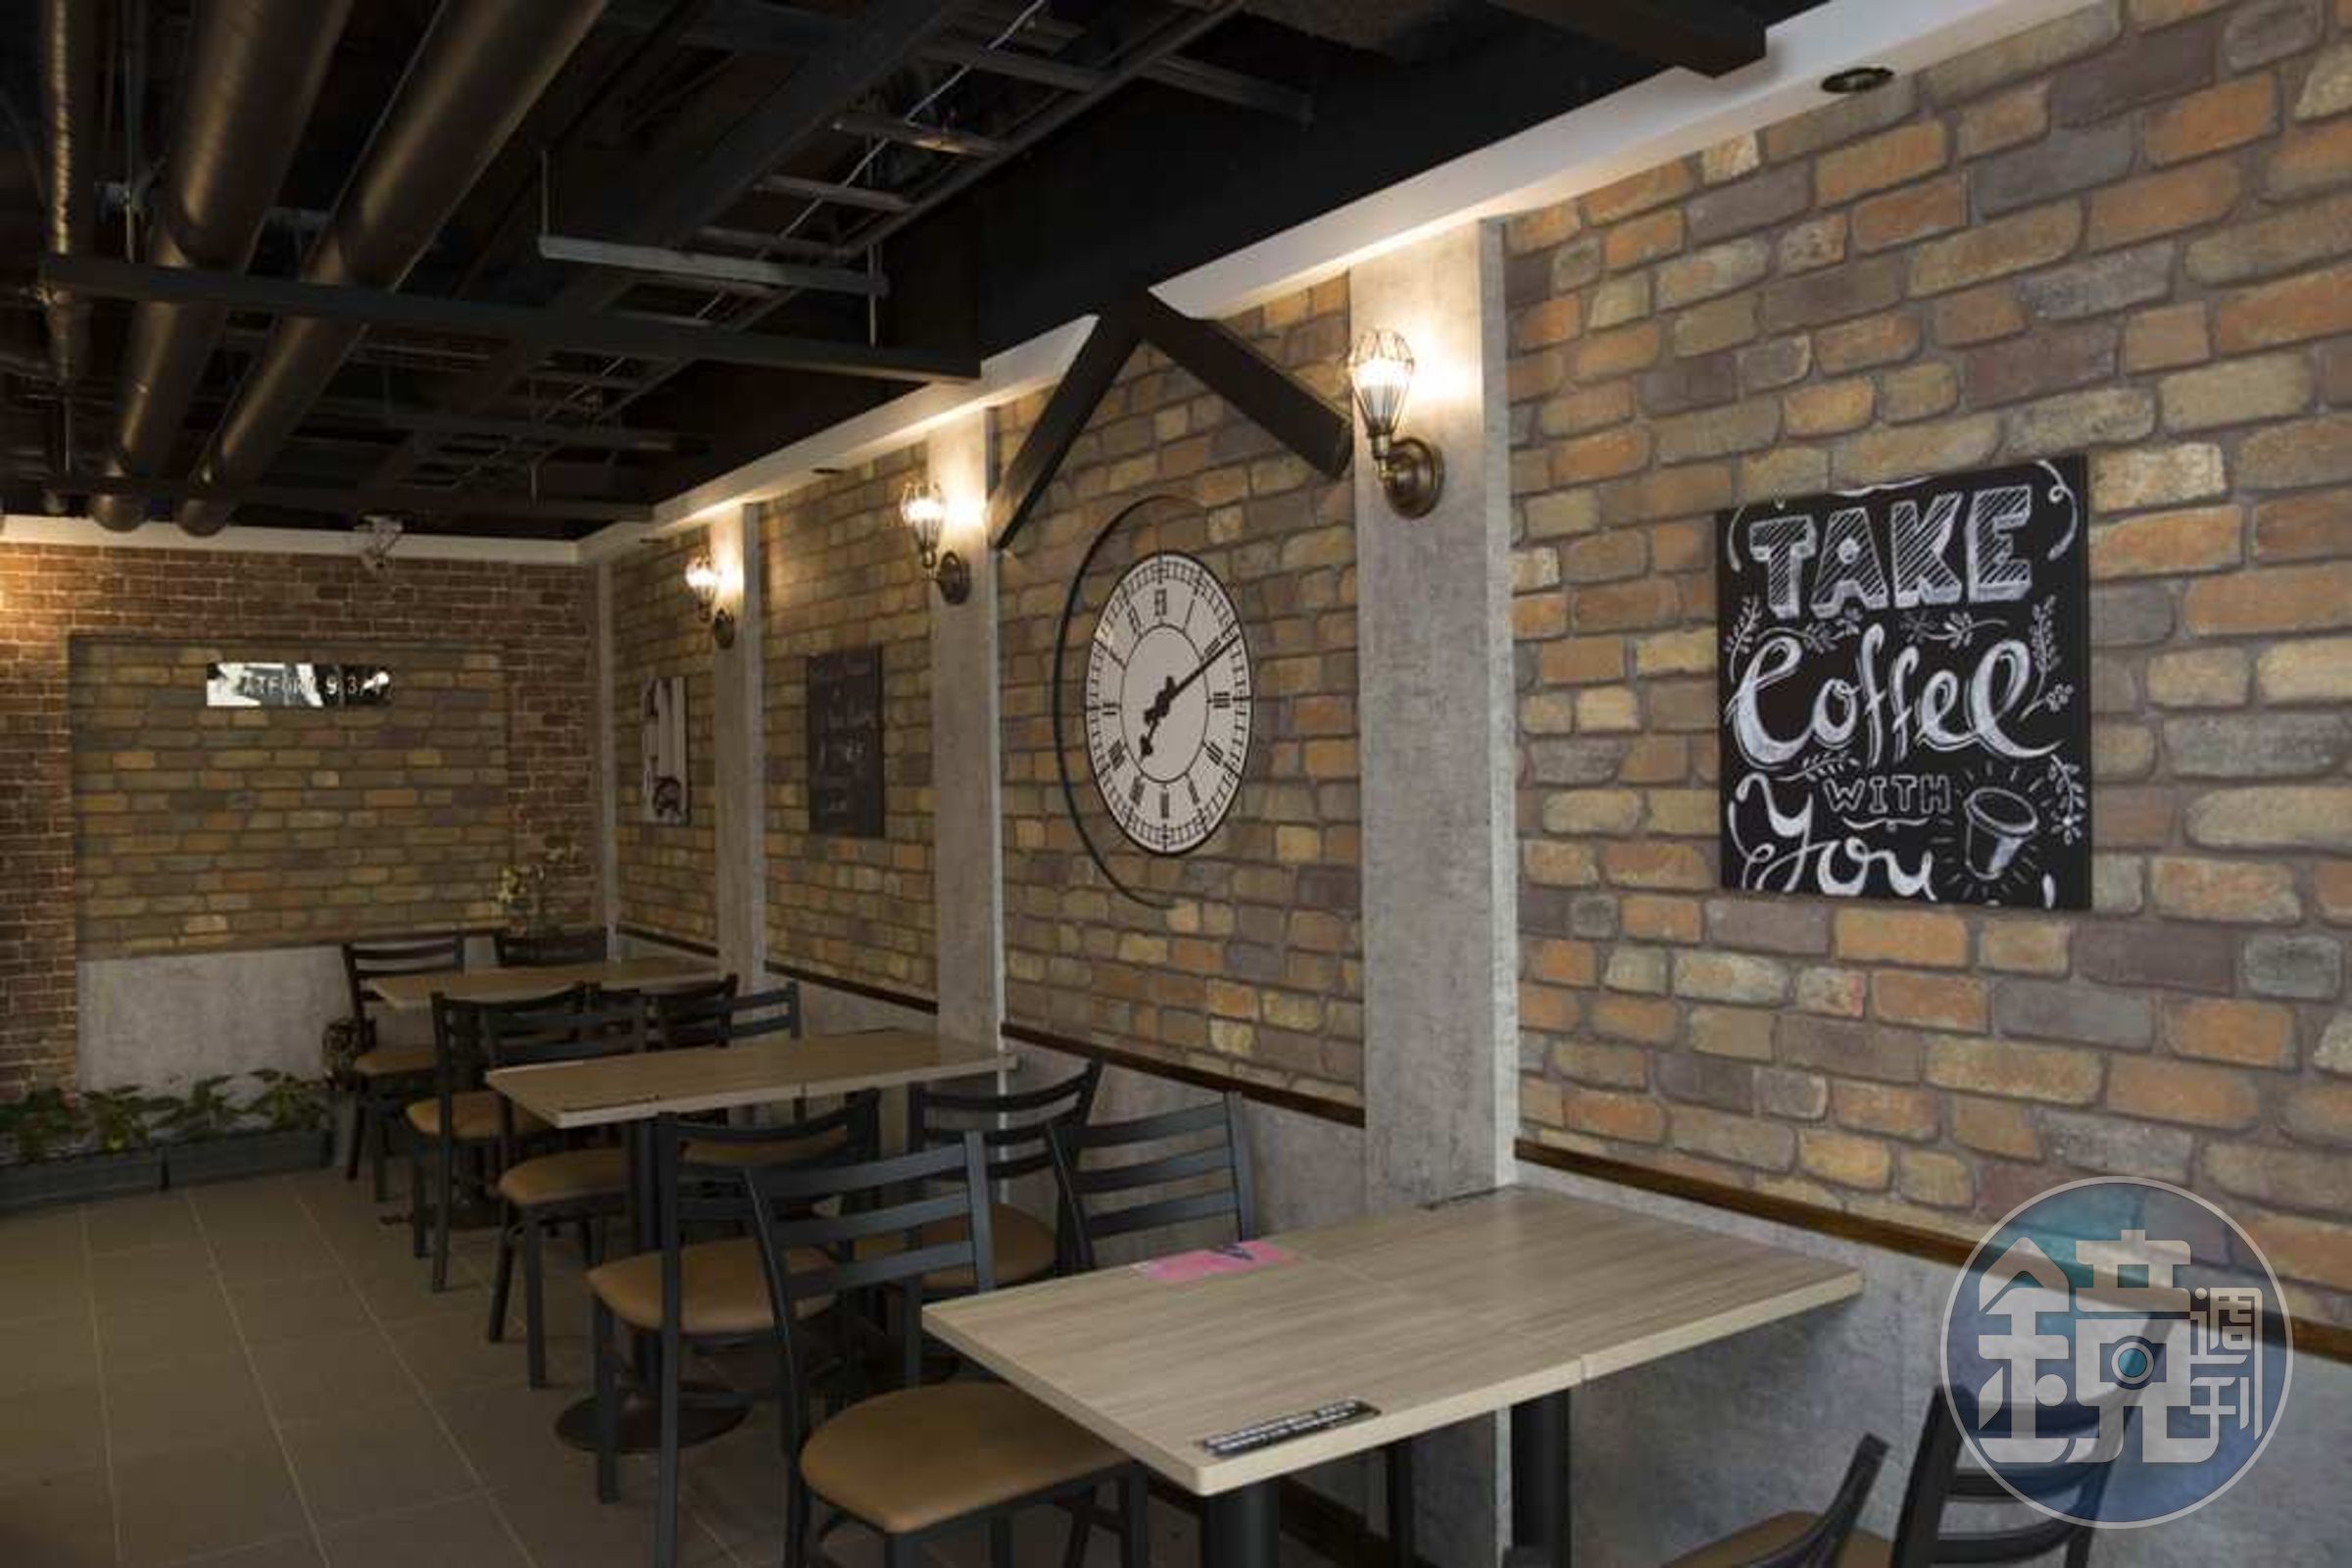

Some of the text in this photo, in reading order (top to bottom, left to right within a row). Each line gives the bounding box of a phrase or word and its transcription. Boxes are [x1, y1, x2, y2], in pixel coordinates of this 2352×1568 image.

[1748, 485, 2033, 619] TAKE
[1726, 623, 2063, 771] Coffee
[1823, 774, 1951, 814] WITH
